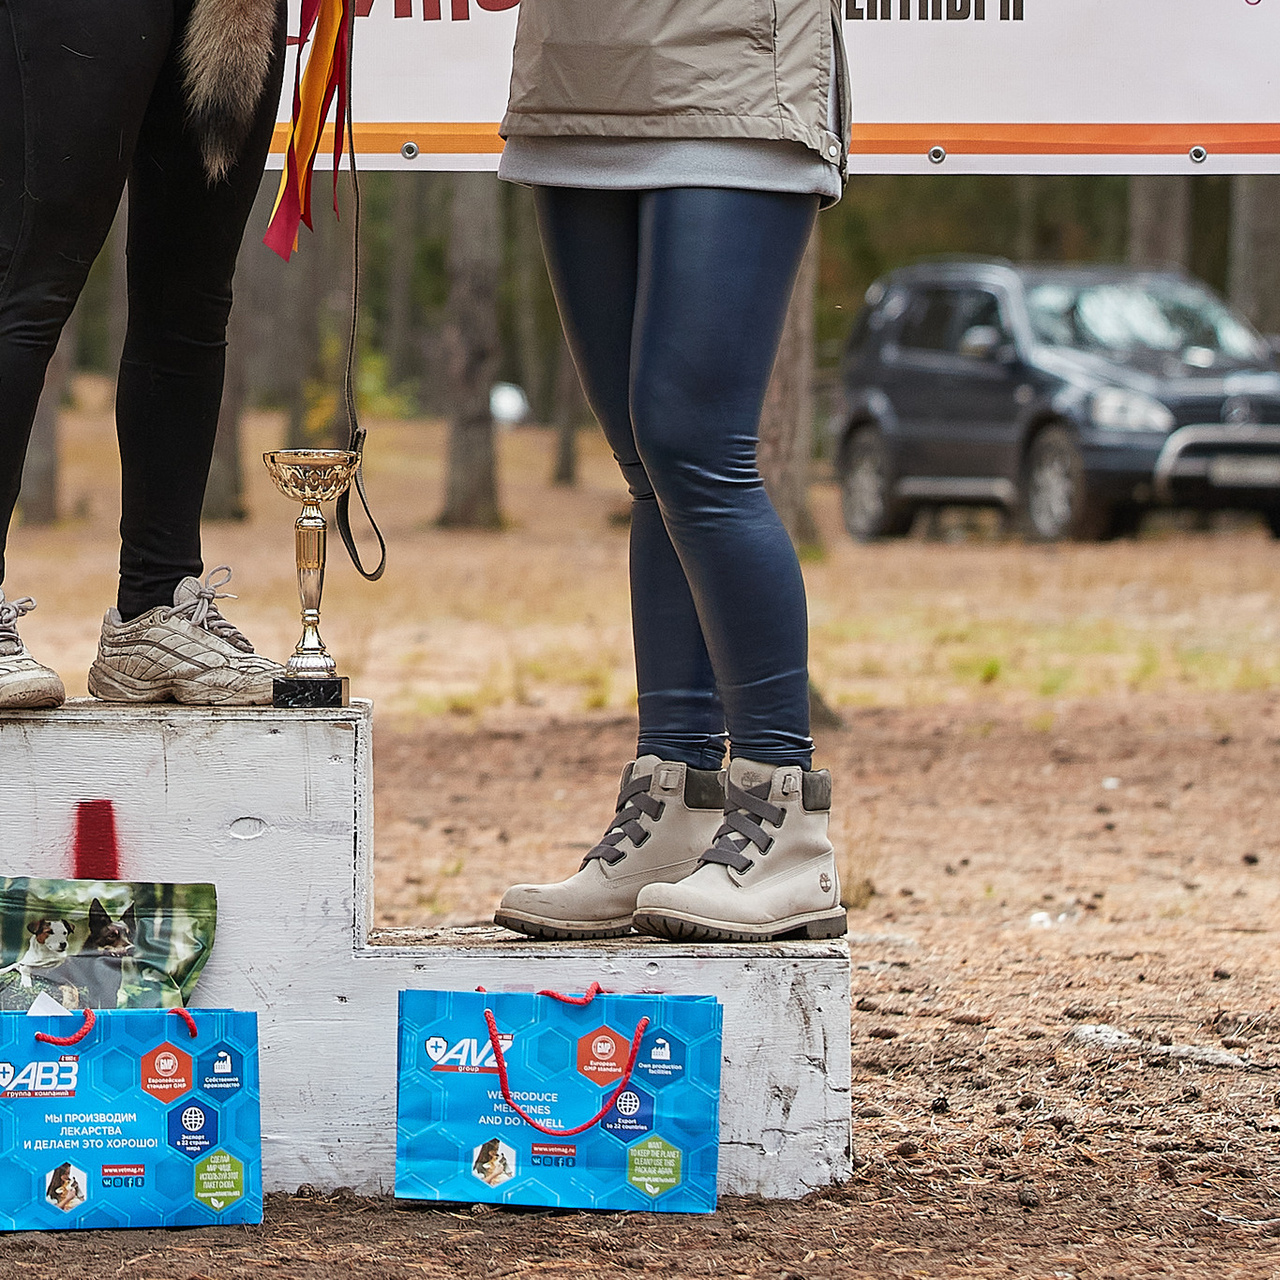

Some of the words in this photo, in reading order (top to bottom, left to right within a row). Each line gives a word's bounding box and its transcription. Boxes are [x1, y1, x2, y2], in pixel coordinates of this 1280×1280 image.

[458, 1065, 479, 1073] group
[589, 1060, 617, 1068] European
[5, 1061, 78, 1090] АВЗ
[487, 1090, 504, 1100] WE
[493, 1103, 551, 1115] MEDCINES
[45, 1113, 62, 1123] МЫ
[65, 1113, 136, 1124] ПРОИЗВОДИМ
[478, 1115, 502, 1125] AND
[505, 1116, 520, 1126] DO
[59, 1126, 122, 1135] ЛЕКАРСТВА
[23, 1140, 32, 1149] И
[34, 1139, 79, 1151] ДЕЛАЕМ
[82, 1139, 103, 1149] ЭТО
[106, 1138, 158, 1148] ХОРОШО!
